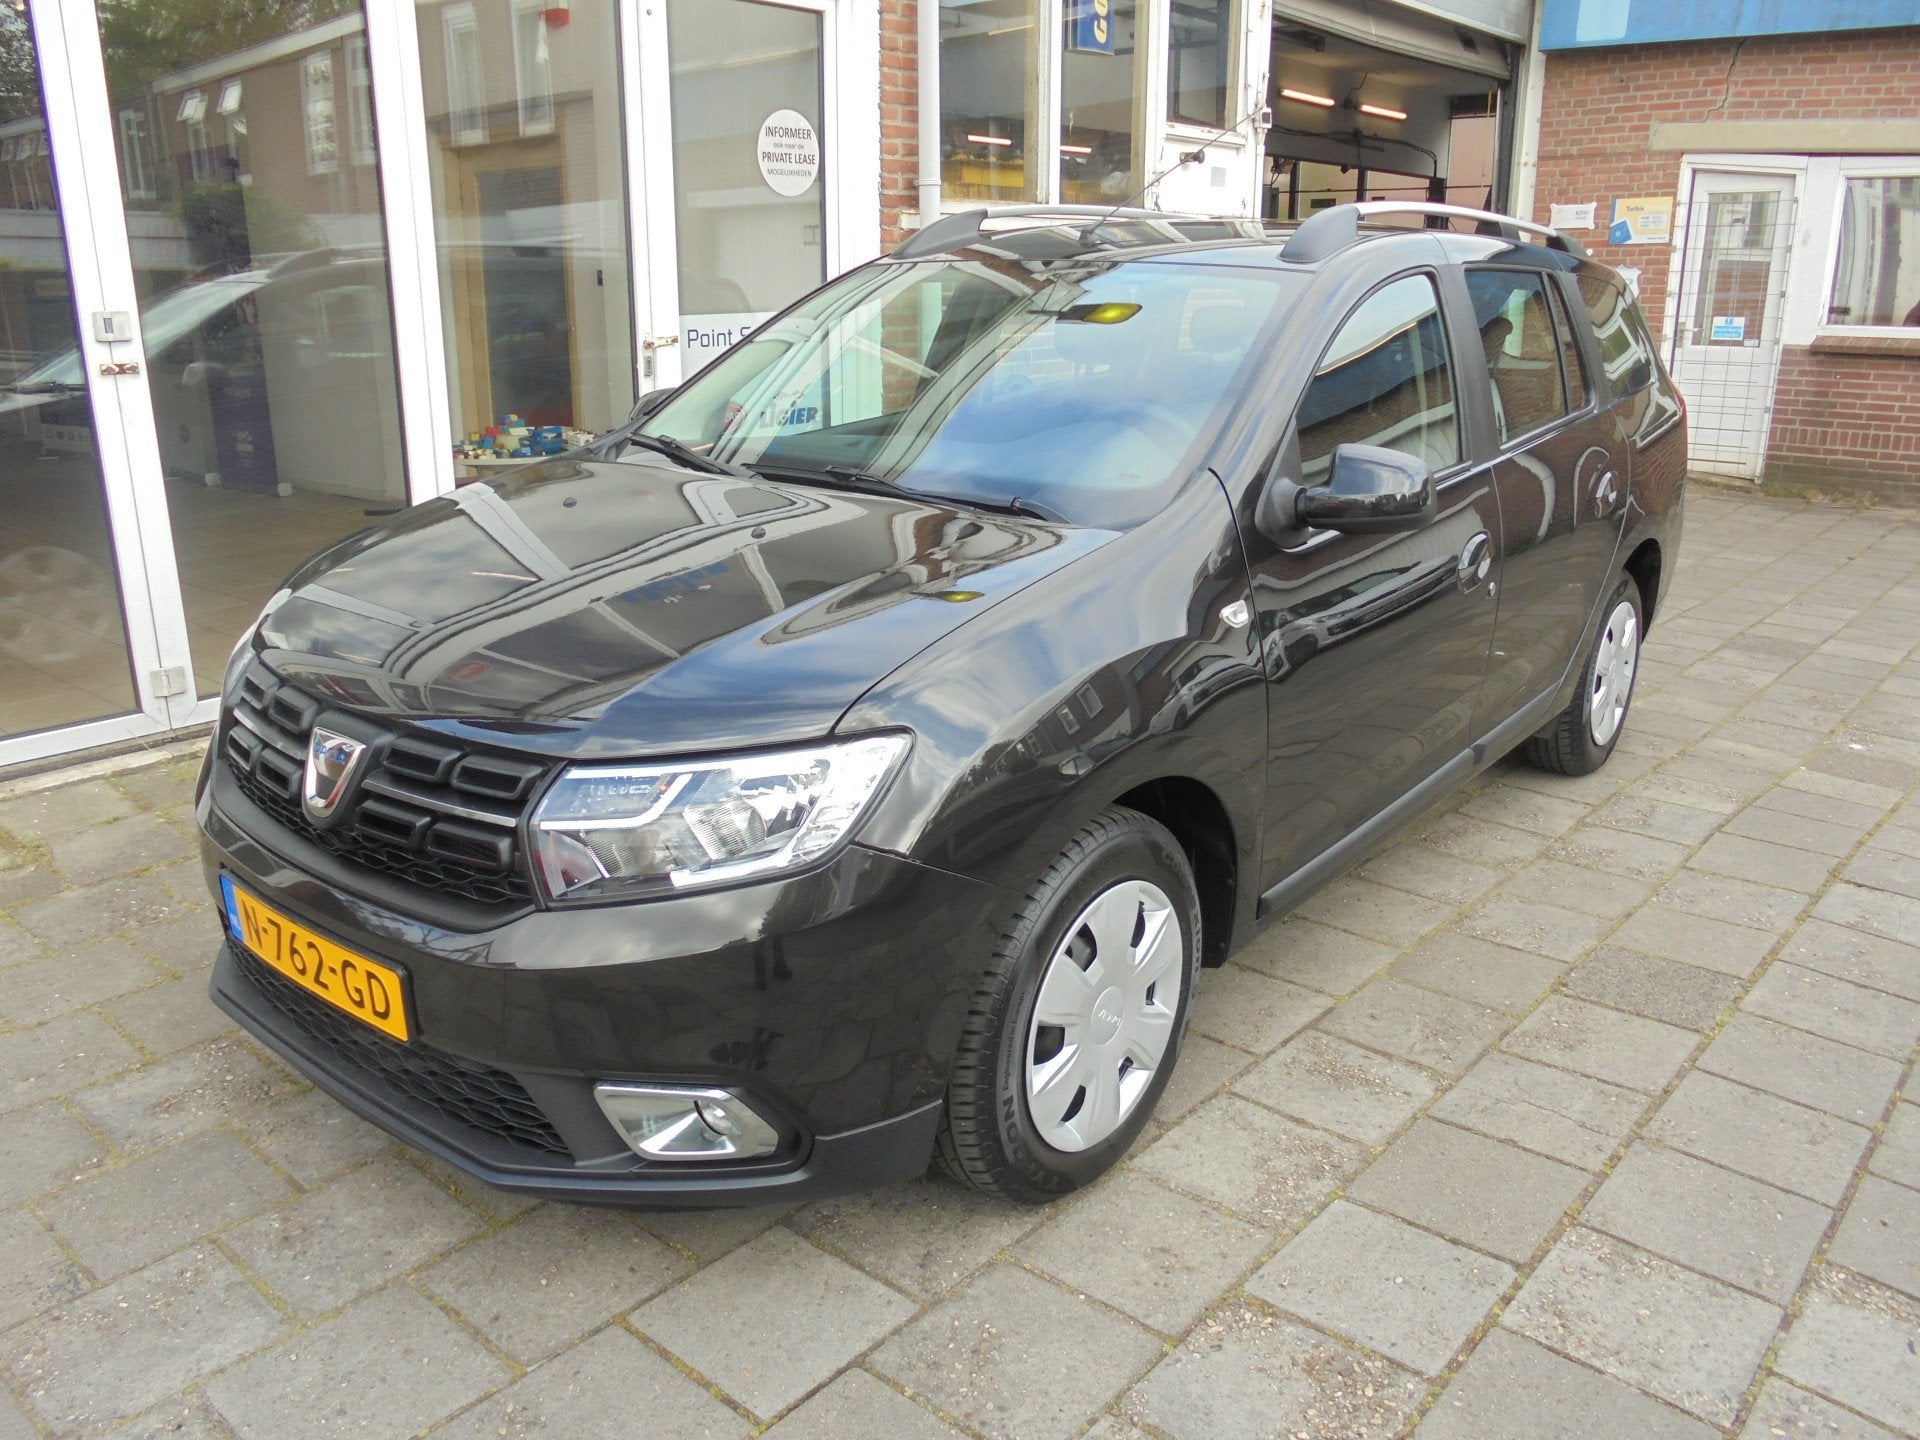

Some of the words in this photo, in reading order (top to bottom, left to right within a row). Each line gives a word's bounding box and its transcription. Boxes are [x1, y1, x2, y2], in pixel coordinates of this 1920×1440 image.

[765, 125, 812, 140] INFORMEER
[762, 151, 793, 164] PRIVATE
[794, 153, 816, 165] LEASE
[687, 328, 733, 349] Point
[759, 406, 819, 429] LIGIER
[241, 898, 391, 1020] N-762-GD
